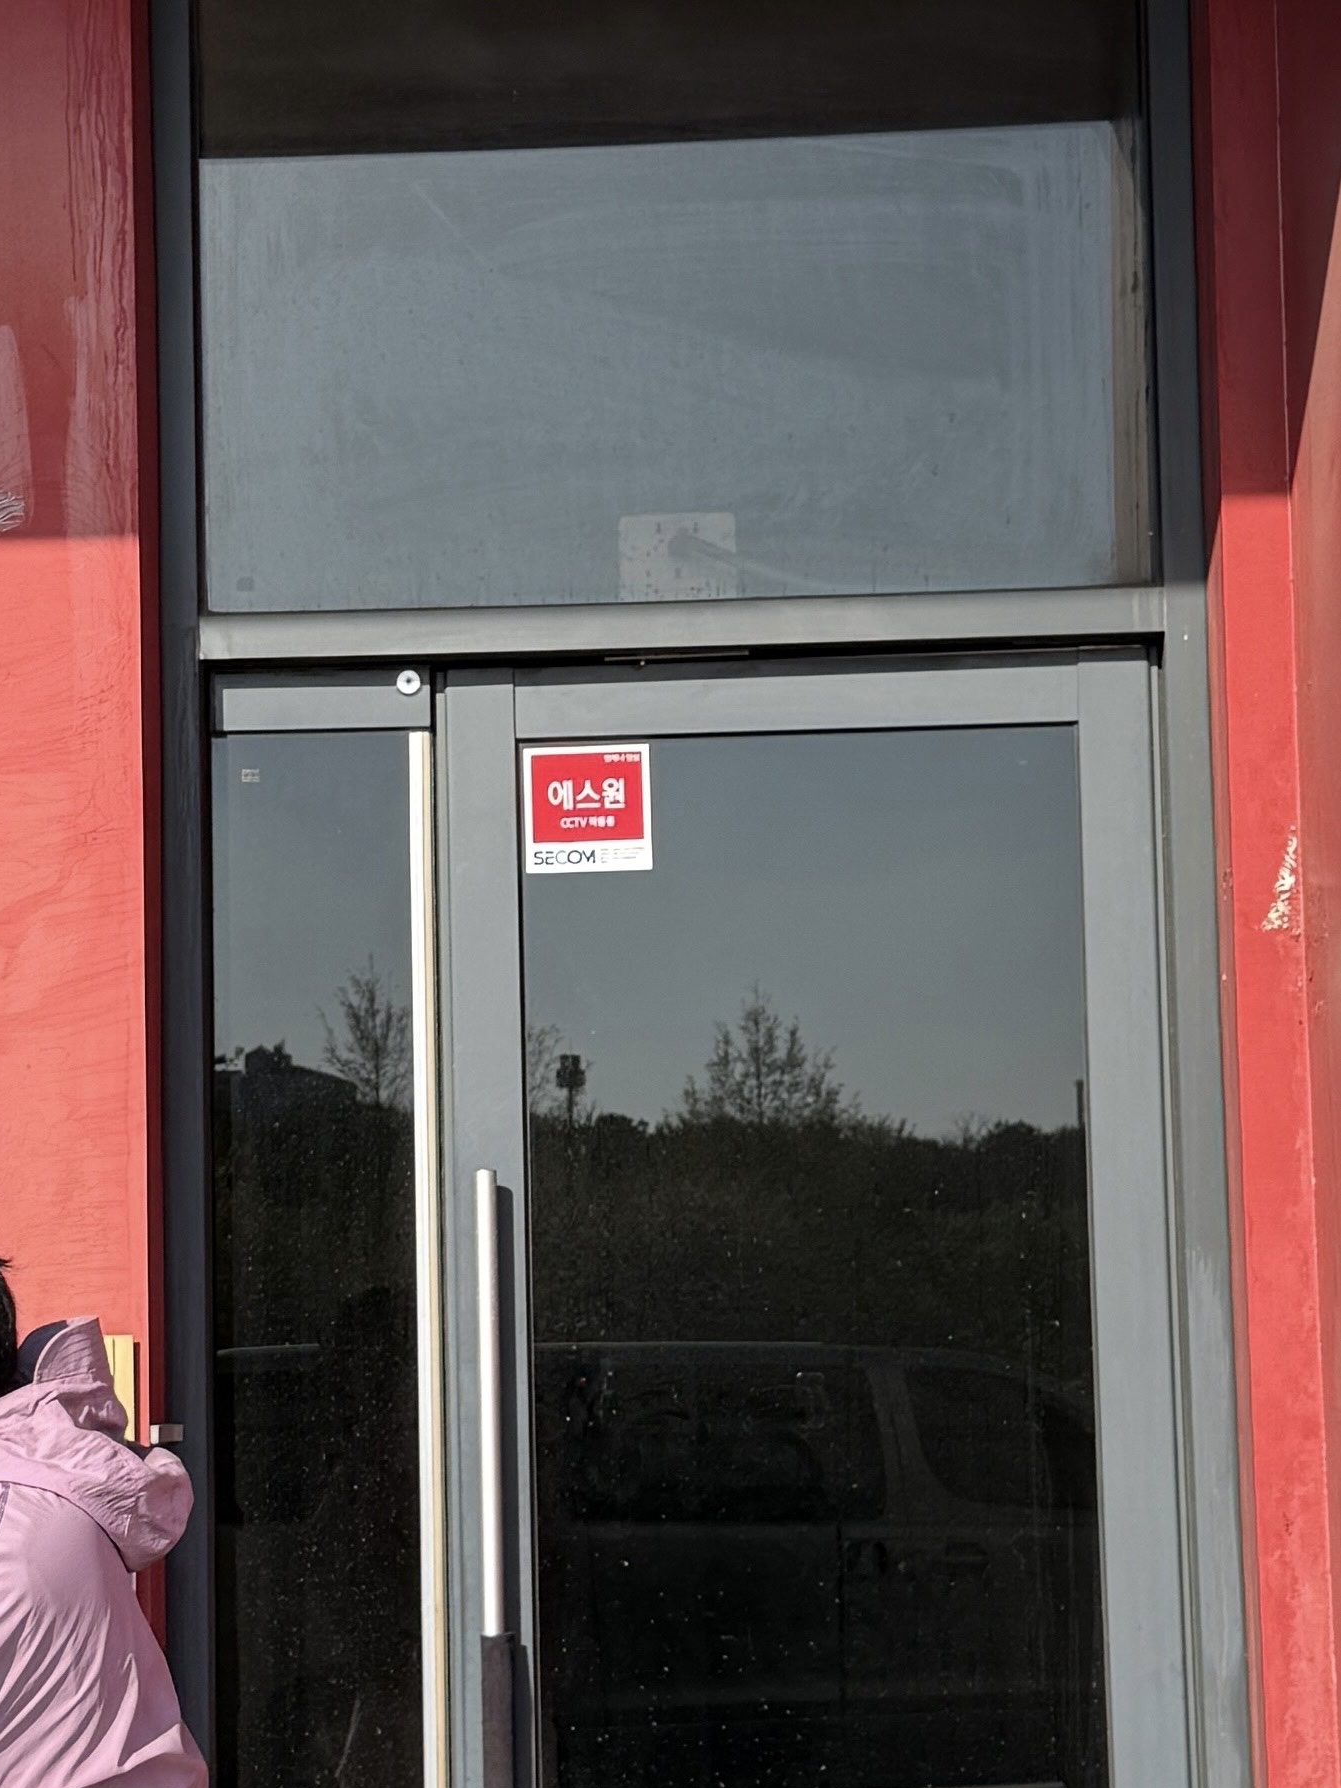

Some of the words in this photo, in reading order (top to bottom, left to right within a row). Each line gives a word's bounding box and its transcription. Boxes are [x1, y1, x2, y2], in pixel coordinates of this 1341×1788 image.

[547, 777, 626, 811] 에스원
[560, 817, 588, 829] CCTV
[533, 849, 596, 866] SECOM
